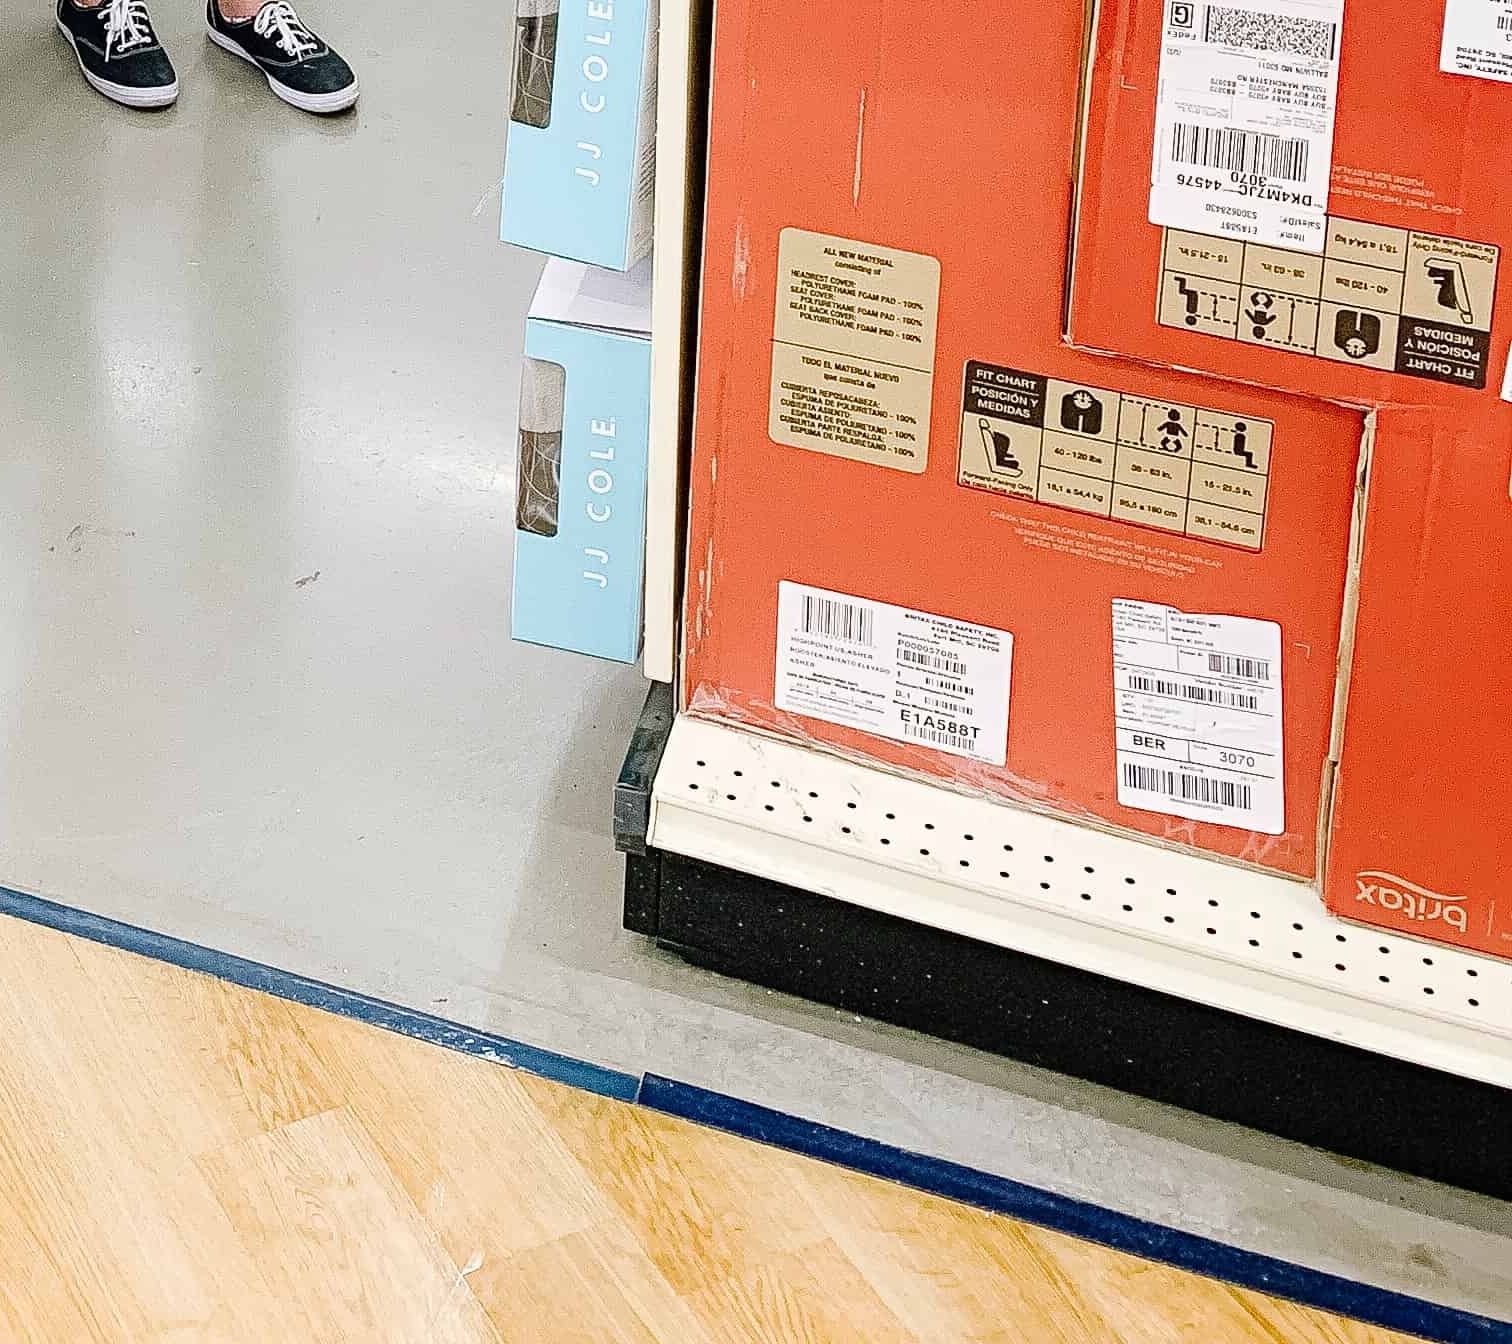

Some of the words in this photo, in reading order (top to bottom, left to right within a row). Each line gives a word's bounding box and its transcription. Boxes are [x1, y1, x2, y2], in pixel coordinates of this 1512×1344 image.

[1174, 4, 1190, 25] G
[1167, 29, 1196, 40] FedEx
[574, 138, 602, 188] JJ
[1176, 174, 1222, 191] 44576
[1230, 171, 1267, 186] 3070
[1404, 337, 1413, 349] Y
[1413, 325, 1474, 346] MEDIDAS
[1414, 338, 1481, 362] POSICIÓN
[1405, 357, 1452, 375] CHART
[1453, 367, 1476, 379] FIT
[976, 369, 994, 381] FIT
[996, 373, 1036, 391] CHART
[970, 385, 1028, 407] POSICIÓN
[1030, 398, 1039, 408] Y
[977, 399, 1031, 419] MEDIDAS
[582, 545, 610, 590] JJ
[901, 709, 982, 740] E1A588T
[1132, 734, 1167, 751] BER
[1219, 751, 1255, 768] 3070
[1354, 878, 1469, 933] britax
